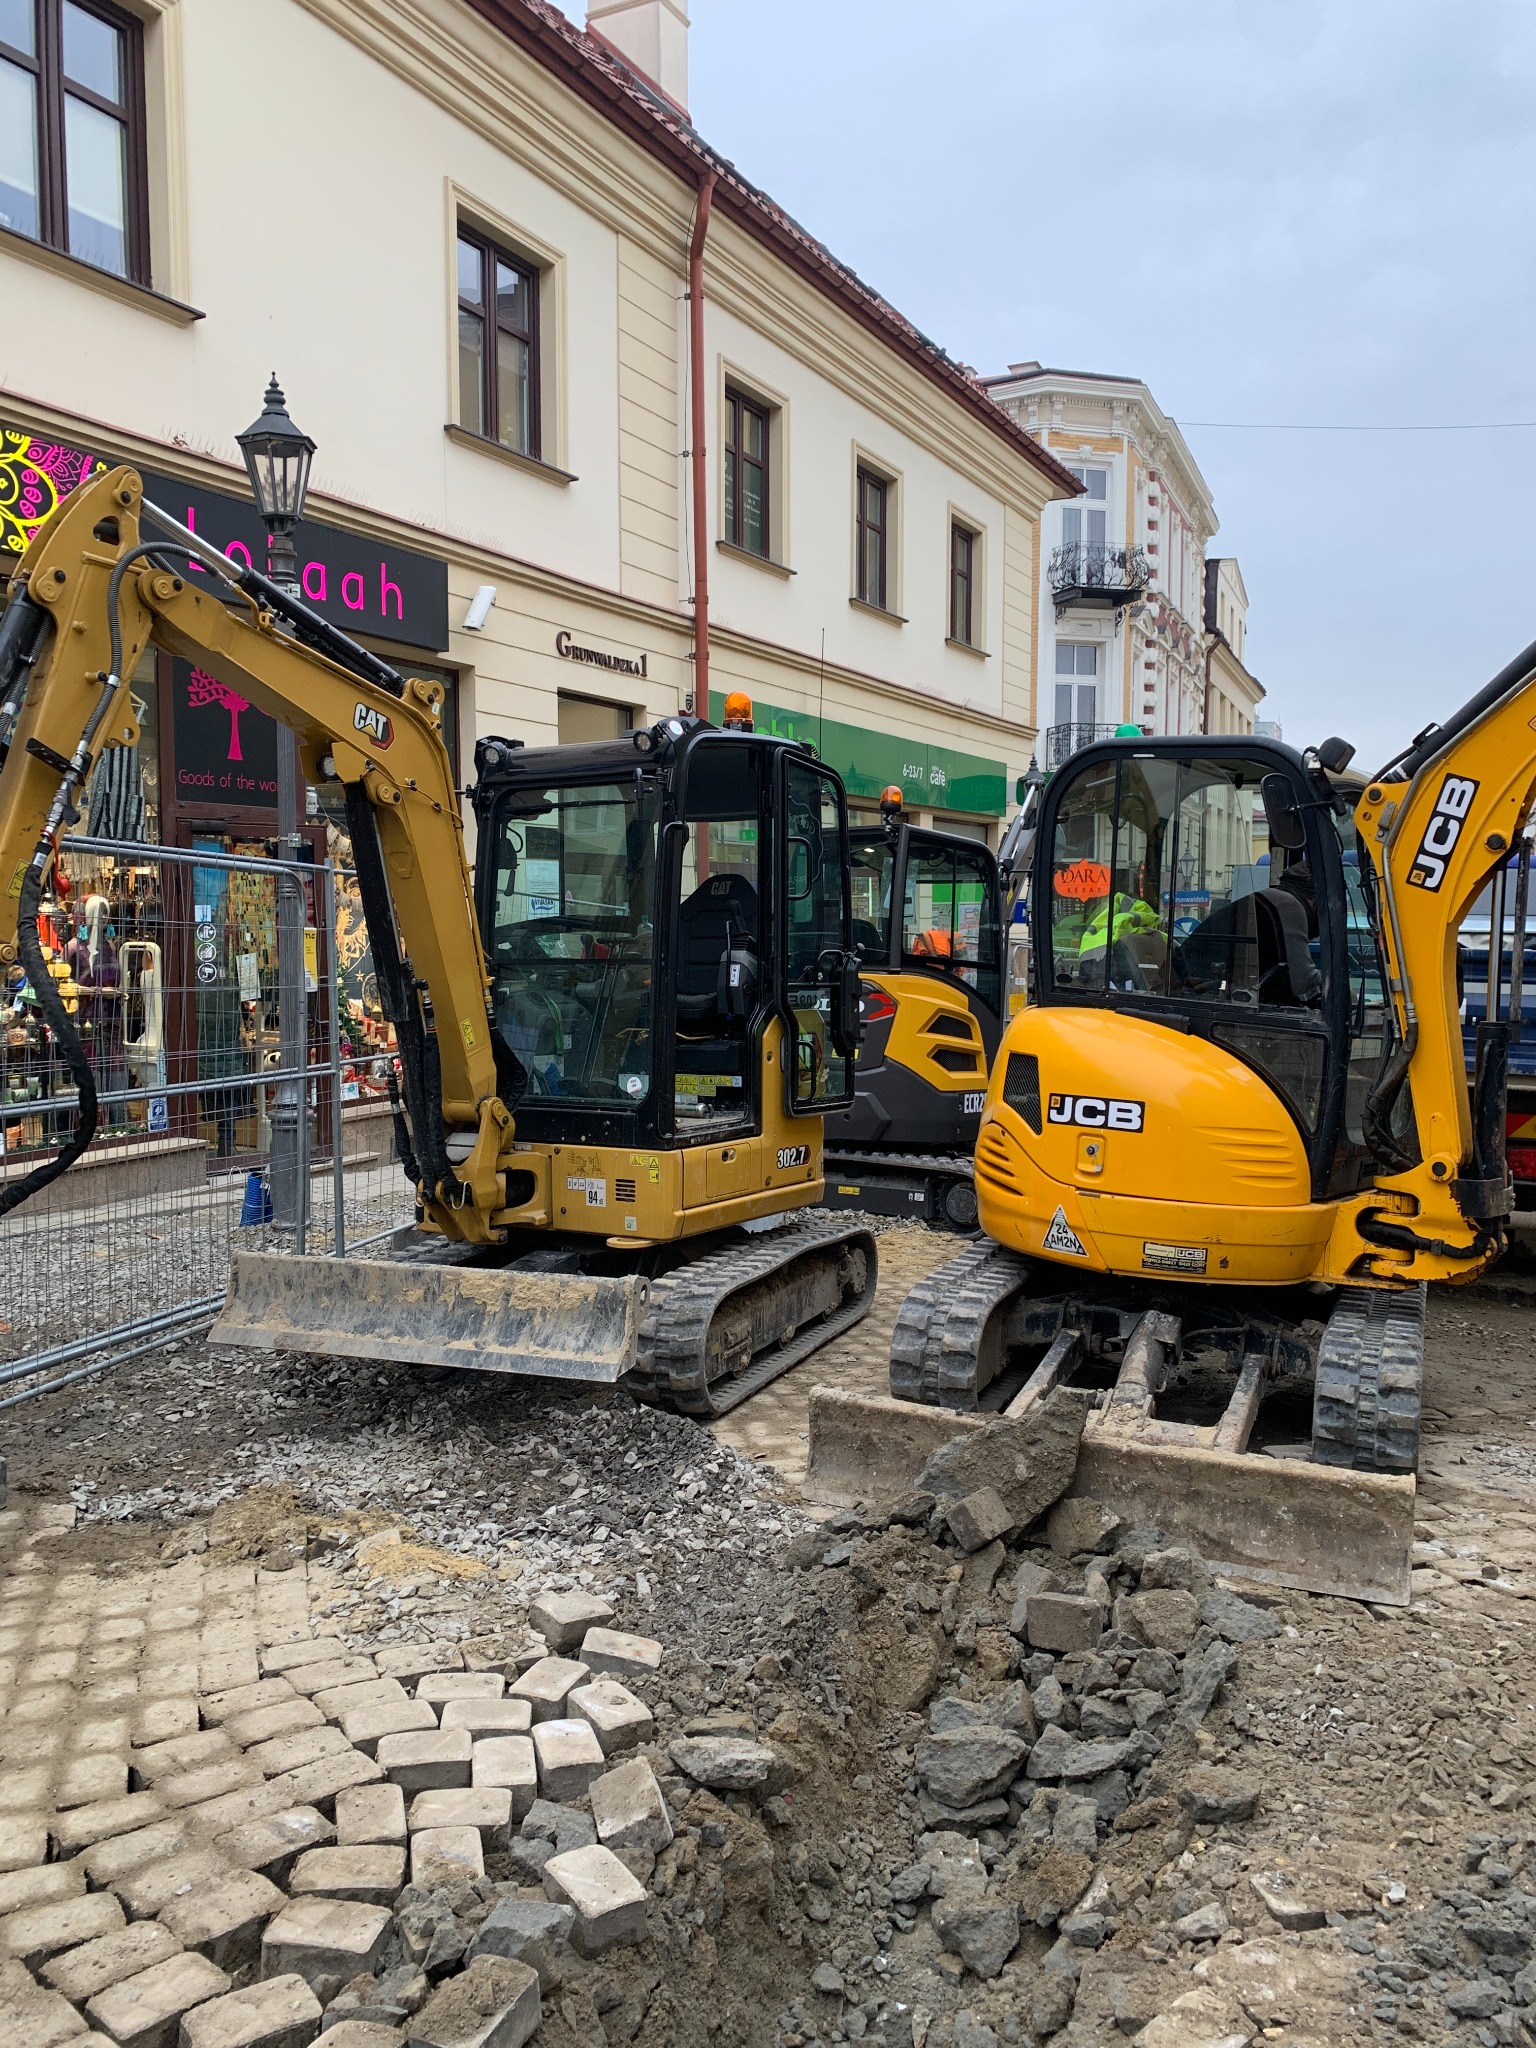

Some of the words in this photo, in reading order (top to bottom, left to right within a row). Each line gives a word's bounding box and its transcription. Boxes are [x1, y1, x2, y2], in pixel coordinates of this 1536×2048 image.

[187, 506, 403, 620] Loaah
[354, 703, 388, 740] CAT
[178, 769, 215, 787] Goods
[219, 773, 232, 788] of
[237, 774, 255, 790] the
[259, 780, 278, 792] wo
[1416, 778, 1475, 888] JCB
[1061, 868, 1108, 884] DARA
[711, 880, 733, 896] CAT
[1049, 1096, 1142, 1130] JCB
[778, 1146, 806, 1169] 302.7
[588, 1190, 598, 1205] 94
[1055, 1223, 1069, 1235] 24
[1051, 1233, 1077, 1250] AM2N
[1177, 1249, 1204, 1258] JCB
